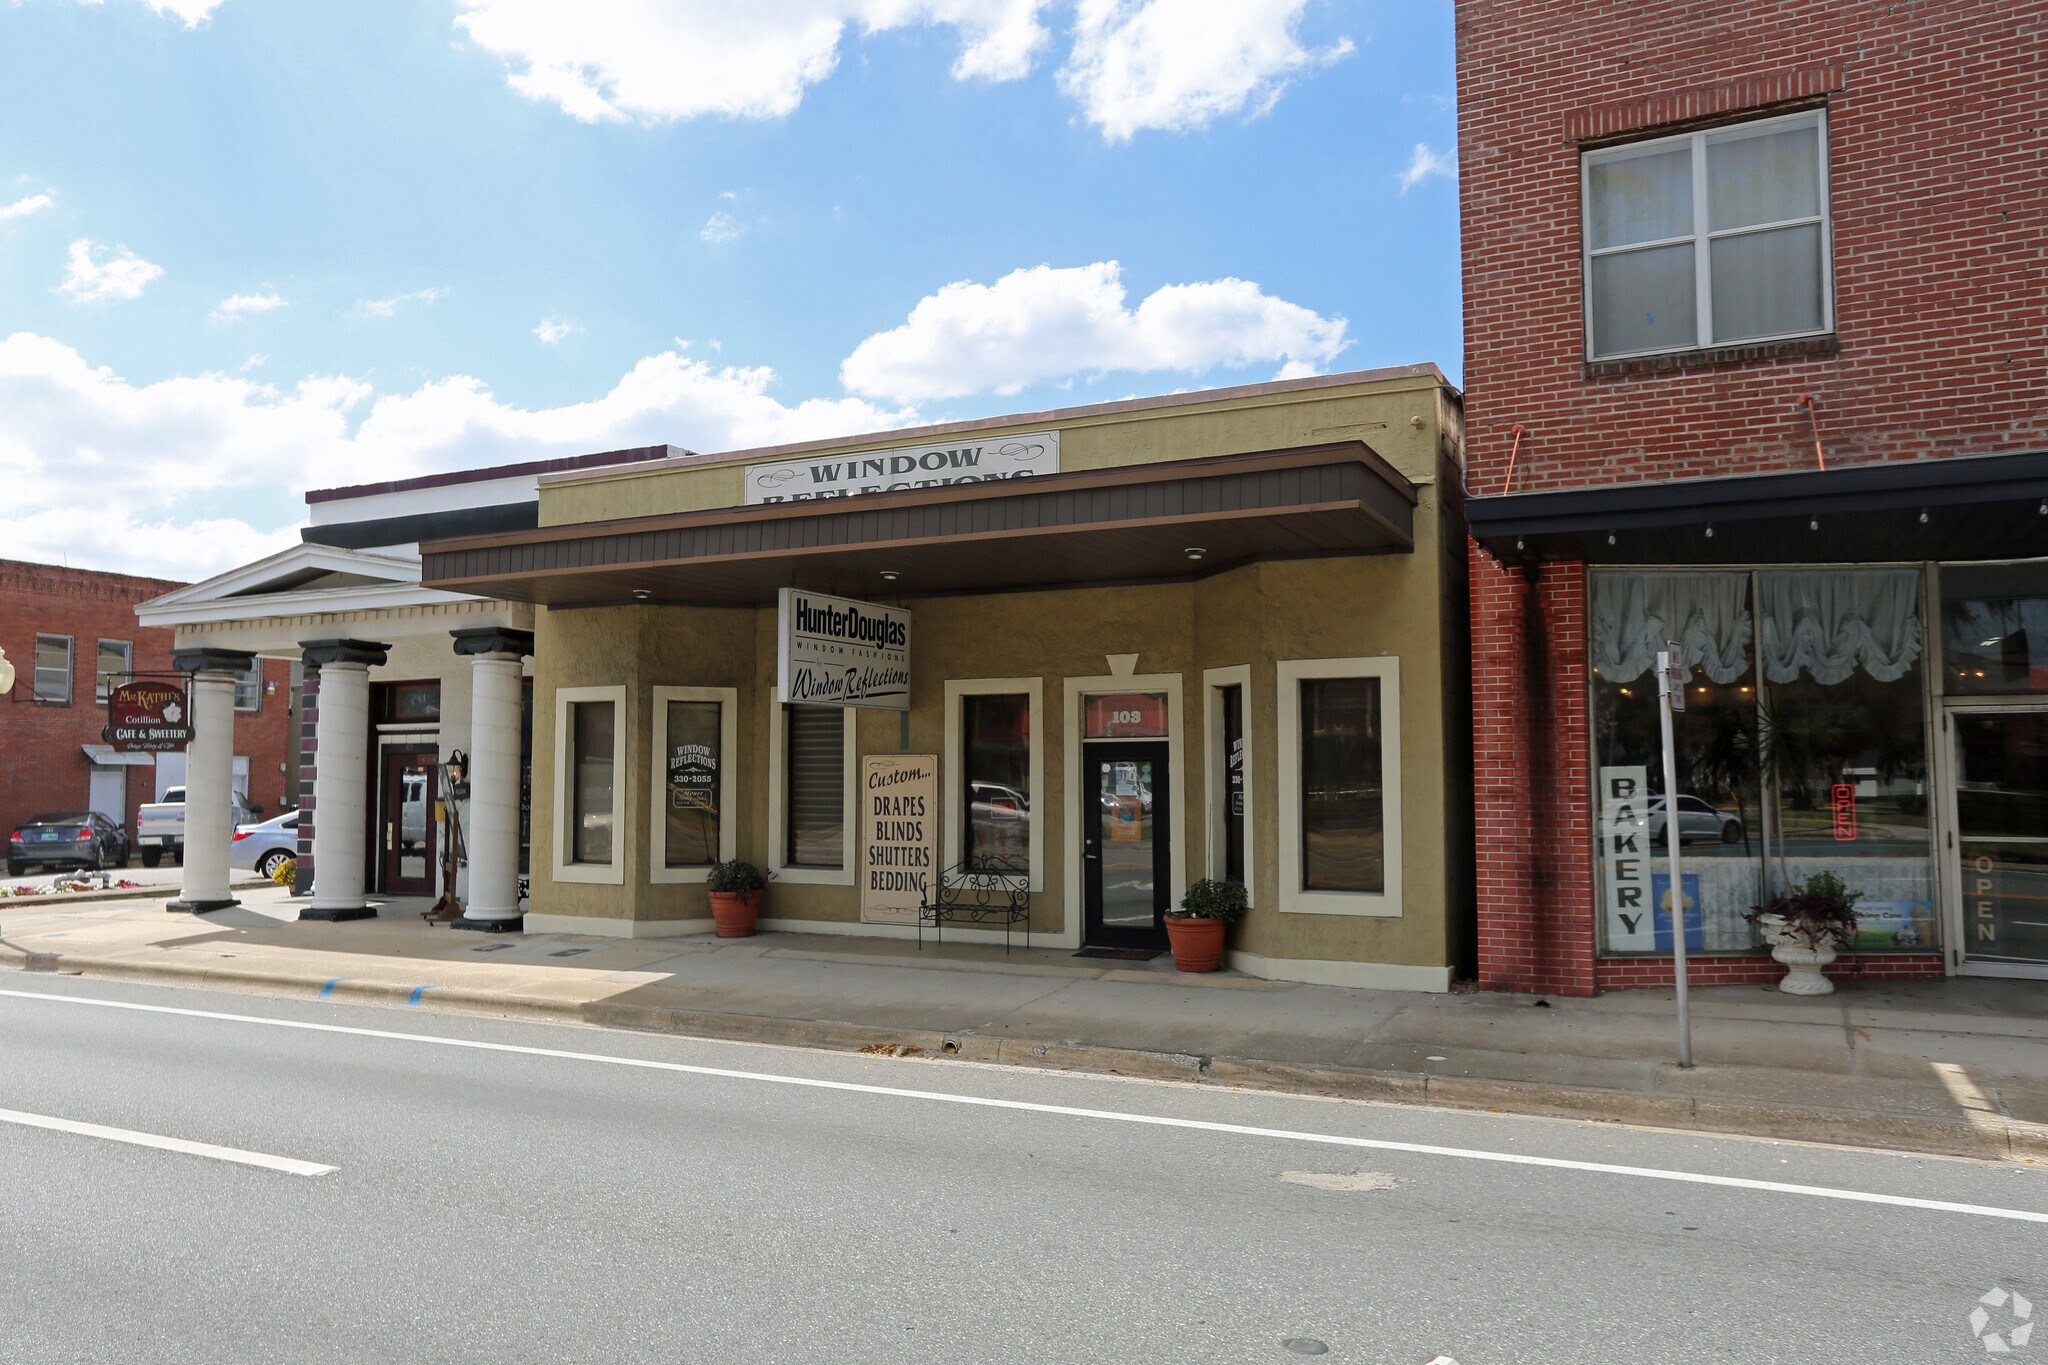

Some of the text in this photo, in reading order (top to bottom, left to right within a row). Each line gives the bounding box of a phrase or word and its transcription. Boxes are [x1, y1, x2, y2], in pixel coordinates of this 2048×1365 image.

[809, 447, 983, 483] WINDOW
[797, 641, 905, 662] WINDOW FASHIONS
[792, 666, 909, 701] Window Reflections
[125, 715, 161, 724] Cotillion
[1112, 710, 1142, 724] 103
[116, 728, 187, 740] CAFE & SWEETERY
[677, 744, 711, 756] WINDOW
[670, 753, 716, 770] REFLECTIONS
[674, 775, 712, 783] 330-2055
[874, 796, 925, 817] DRAPES
[1836, 787, 1852, 837] OPEN
[876, 821, 923, 842] BLINDS
[869, 845, 930, 868] SHUTTERS
[1611, 778, 1643, 934] BAKERY
[870, 871, 927, 893] BEDDING
[1974, 856, 1996, 941] OPEN
